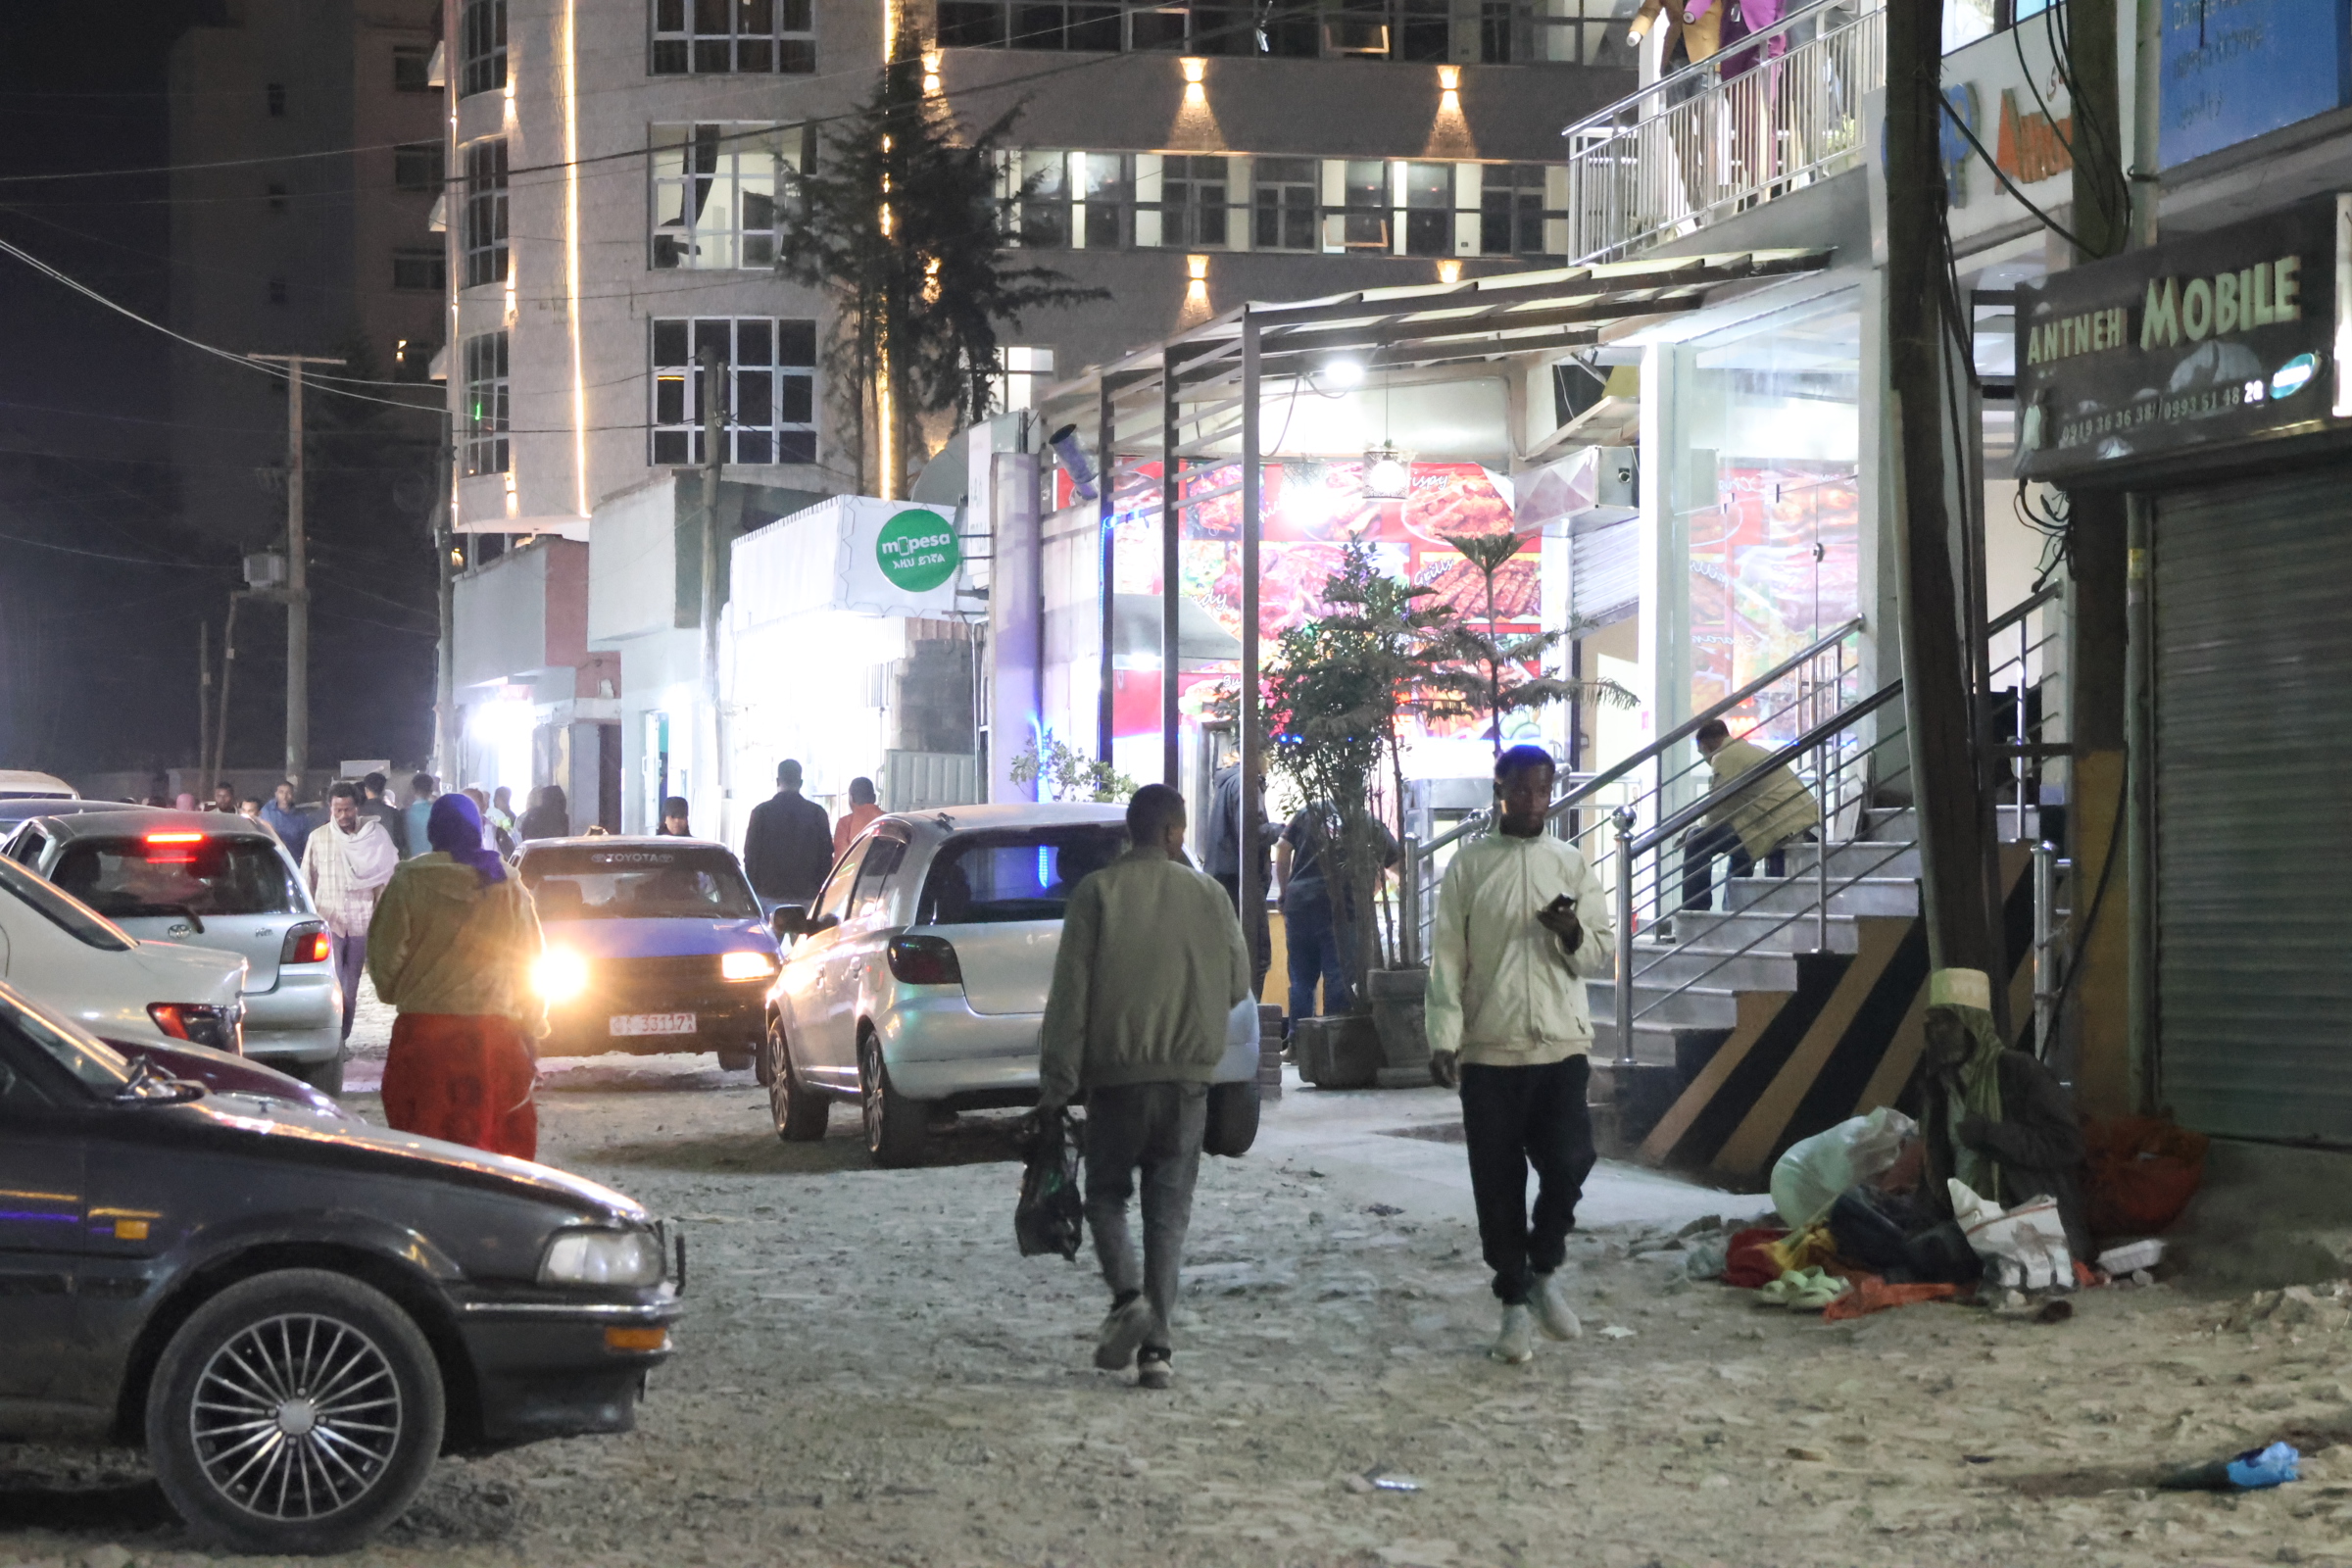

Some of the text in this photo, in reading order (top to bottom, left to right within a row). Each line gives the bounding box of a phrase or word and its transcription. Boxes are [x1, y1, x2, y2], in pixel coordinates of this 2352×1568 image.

[2027, 255, 2301, 366] ANTNEH MOBILE
[2062, 419, 2093, 441] 0919
[2096, 414, 2112, 433] 36
[2116, 409, 2132, 428] 36
[606, 853, 659, 862] TOYOTA
